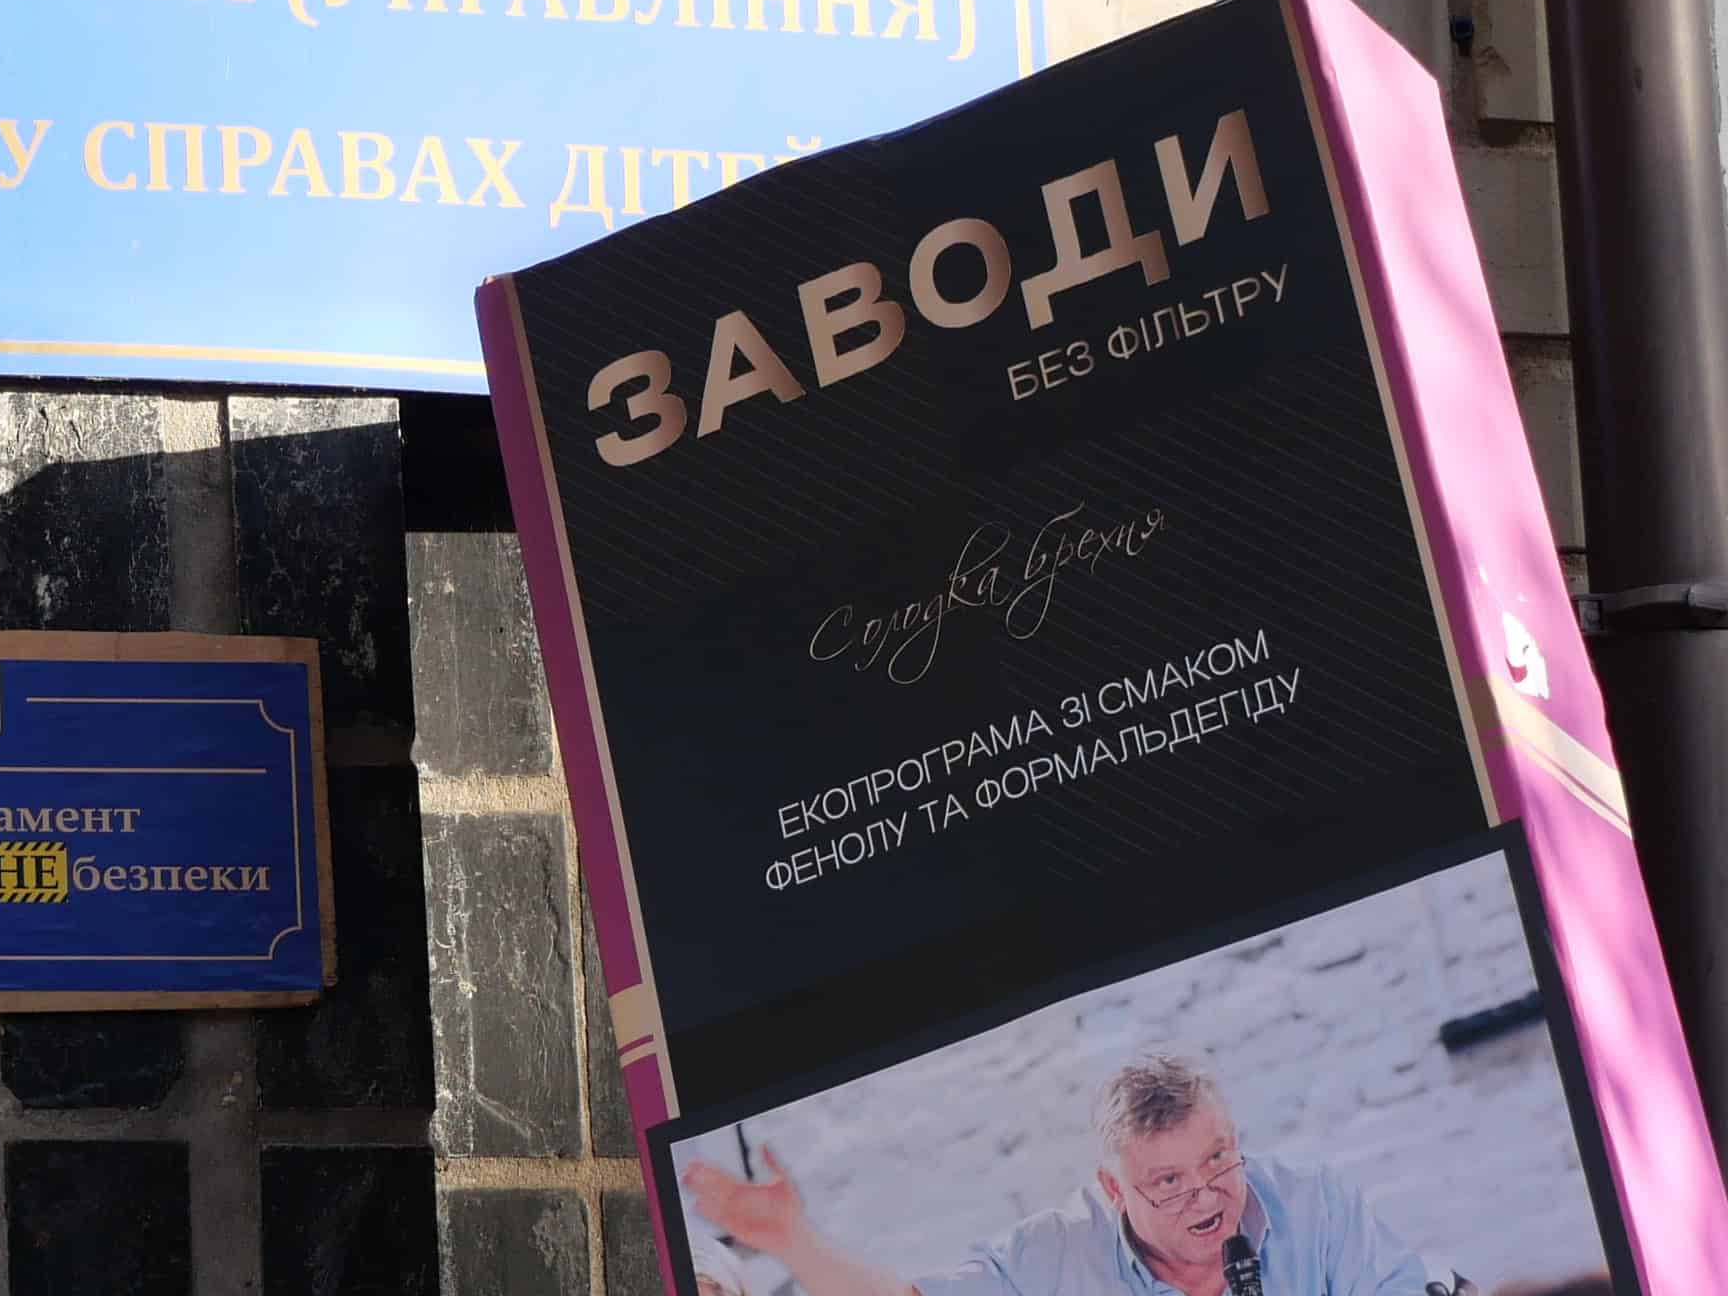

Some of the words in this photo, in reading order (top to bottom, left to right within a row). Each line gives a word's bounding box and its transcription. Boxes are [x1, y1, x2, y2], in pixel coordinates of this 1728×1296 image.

[82, 119, 526, 211] СПРАВАХ
[586, 109, 1271, 469] ЗАВОДИ
[1006, 340, 1097, 402] БЕЗ
[1106, 263, 1289, 364] ФІЛЬТРУ
[763, 813, 909, 893] ФЕНОЛУ
[918, 786, 969, 833] ТА
[974, 668, 1302, 815] ФОРМАЛЬДЕГІДУ
[777, 709, 1053, 840] ЕКОПРОГРАМА
[1059, 692, 1094, 728] ЗІ
[1098, 629, 1270, 715] СМАКОМ
